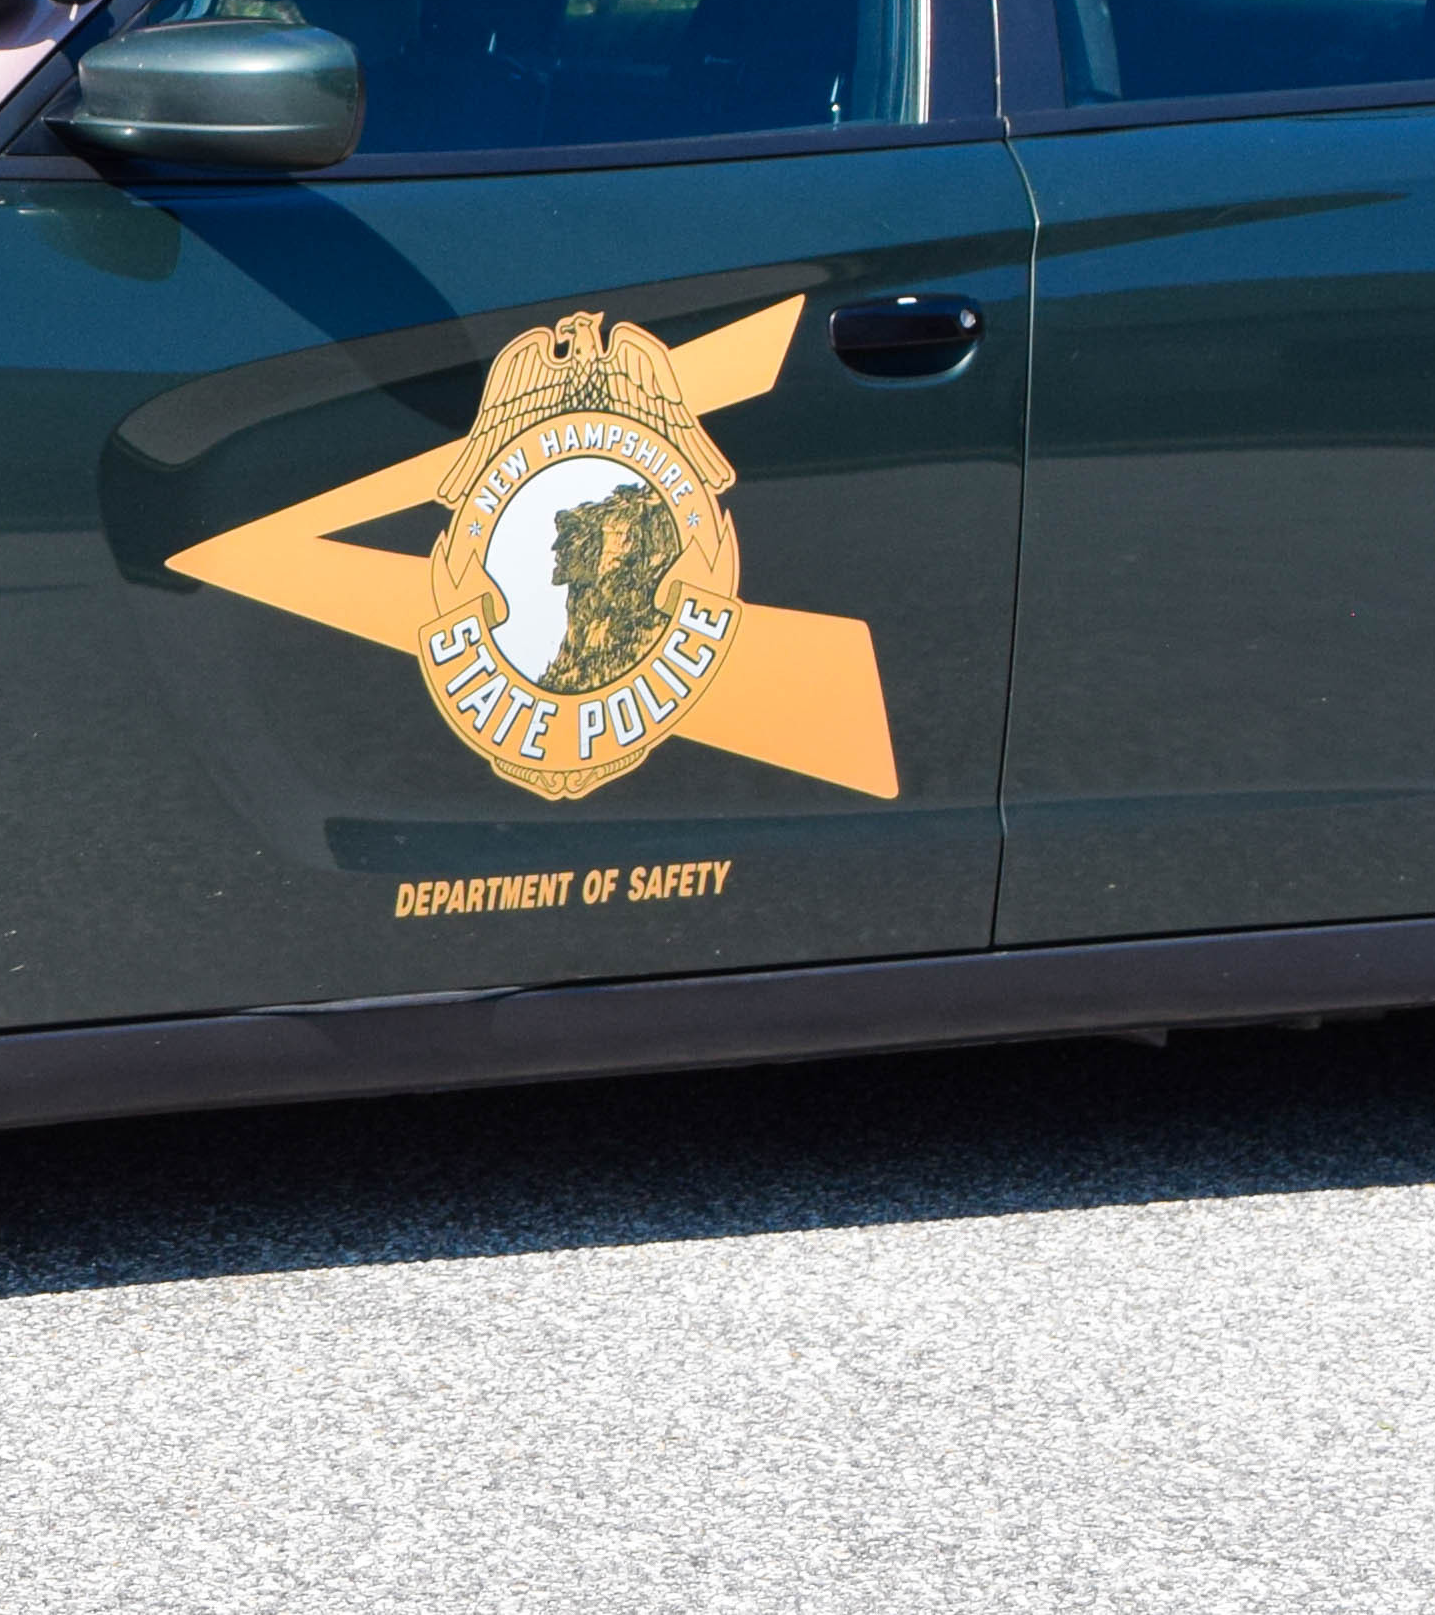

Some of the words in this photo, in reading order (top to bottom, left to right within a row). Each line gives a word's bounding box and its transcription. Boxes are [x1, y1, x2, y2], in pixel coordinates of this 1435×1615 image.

[473, 448, 530, 515] NEW
[540, 422, 696, 506] HAMPSHIRE
[429, 615, 559, 760] STATE
[578, 597, 735, 760] POLICE
[394, 871, 574, 918] DEPARTMENT
[582, 868, 619, 905] OF
[627, 860, 731, 902] SAFETY
